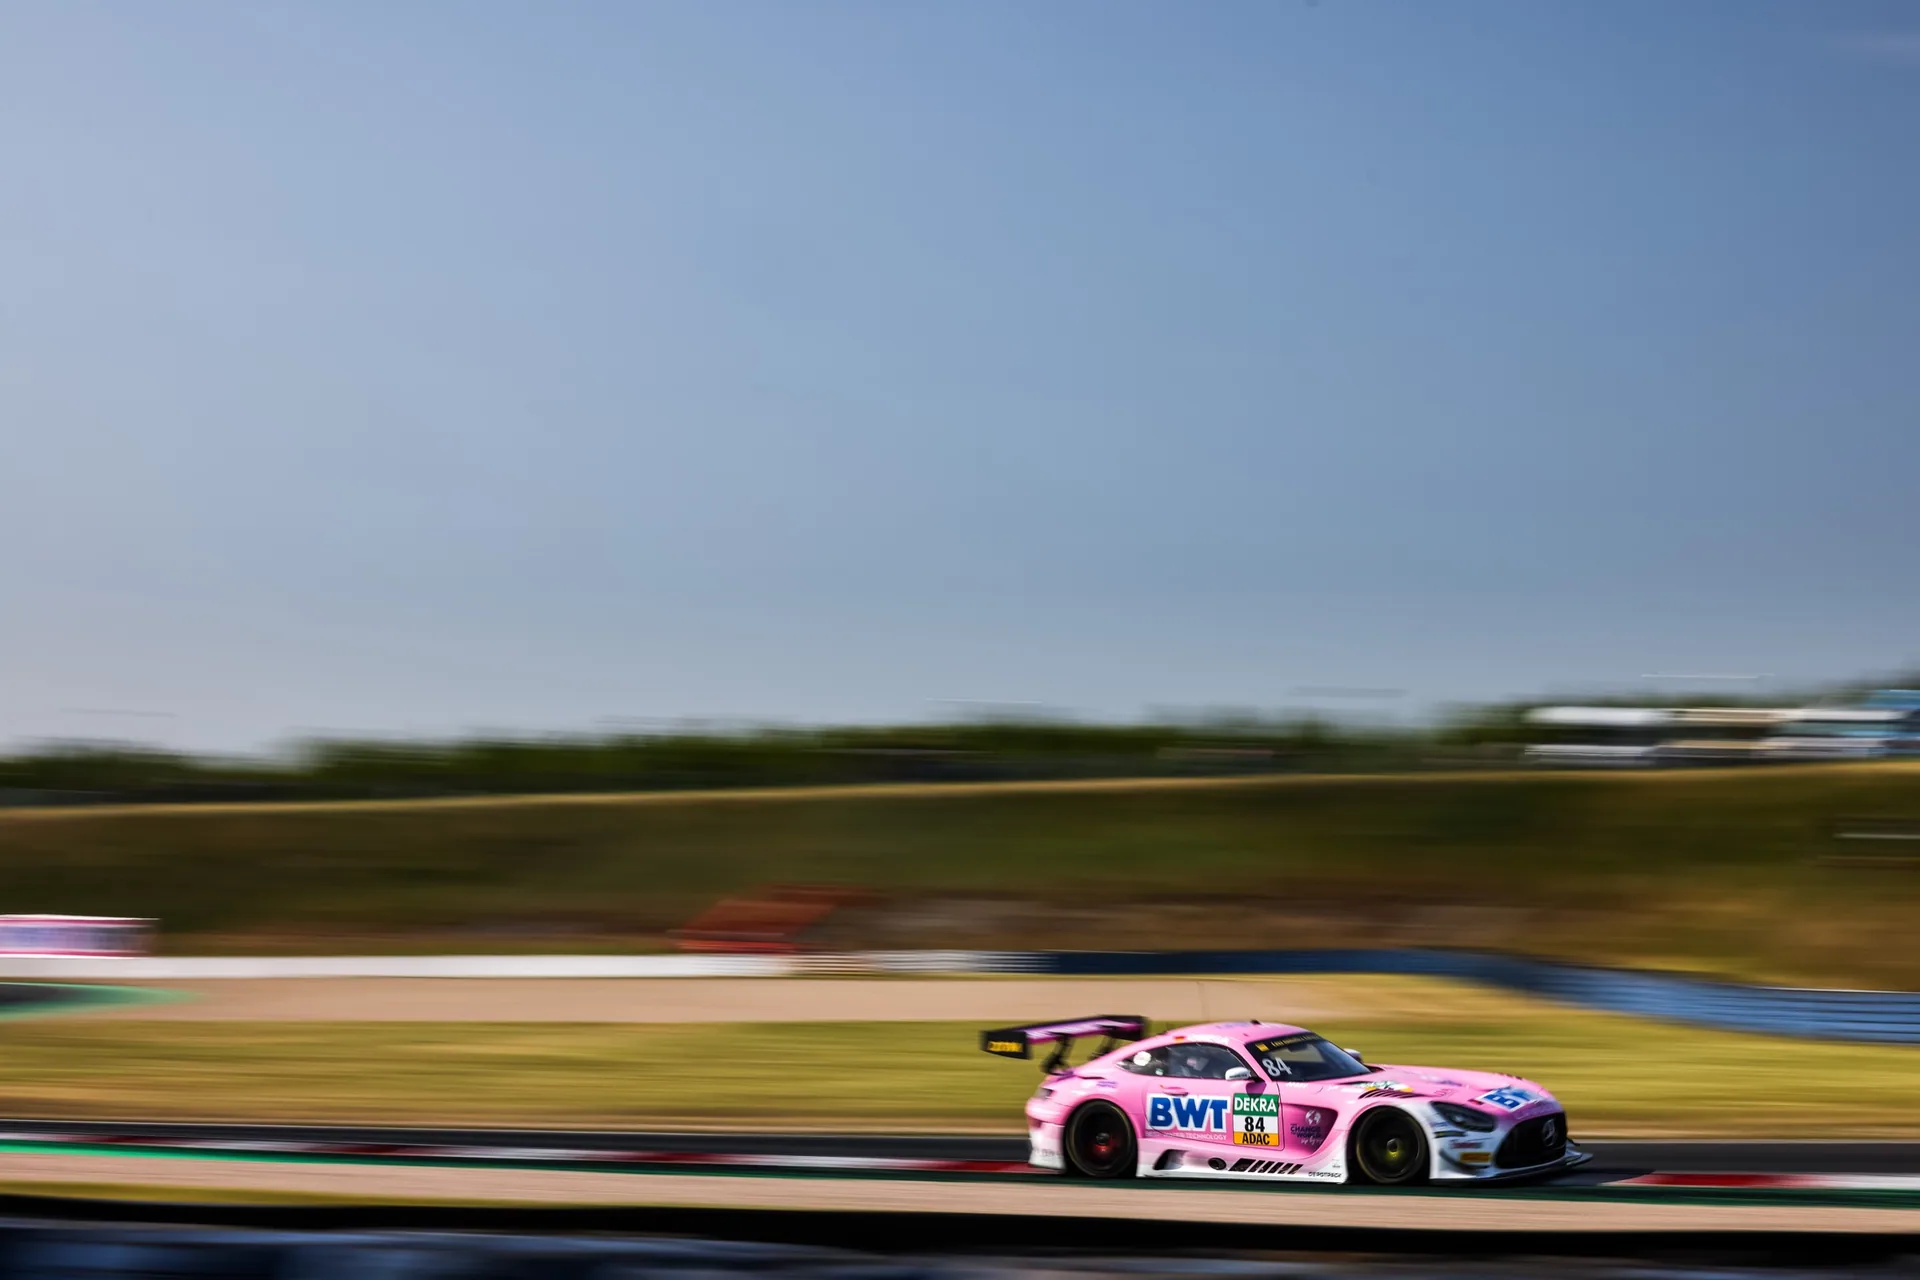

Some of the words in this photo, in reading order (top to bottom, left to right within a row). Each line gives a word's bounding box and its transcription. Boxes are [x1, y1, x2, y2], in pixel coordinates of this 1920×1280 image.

[1262, 1056, 1292, 1077] 84
[1149, 1096, 1228, 1130] BWT
[1234, 1096, 1277, 1113] DEKRA
[1244, 1116, 1265, 1133] 84
[1242, 1132, 1270, 1145] ADAC
